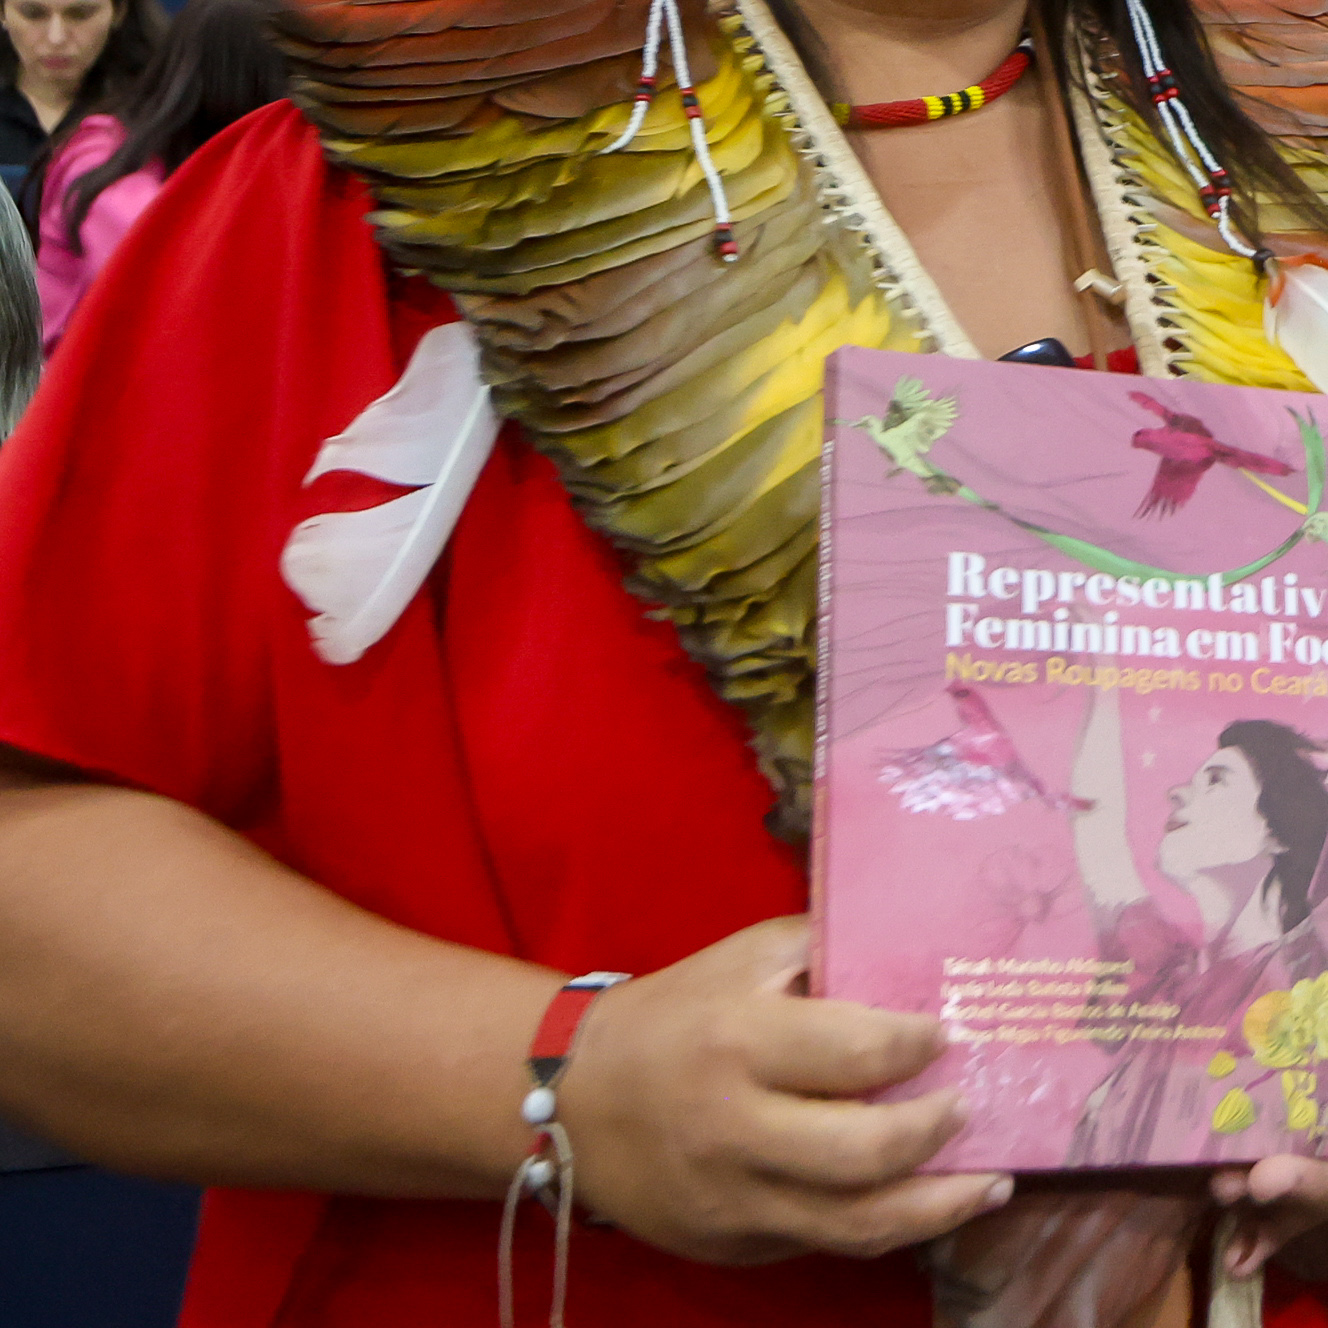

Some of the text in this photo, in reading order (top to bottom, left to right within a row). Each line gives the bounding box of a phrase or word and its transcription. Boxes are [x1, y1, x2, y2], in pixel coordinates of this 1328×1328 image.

[945, 602, 1181, 658] Feminina
[1186, 628, 1261, 663] em
[945, 651, 1038, 684] Novas
[1045, 656, 1200, 695] Roupagens
[1208, 672, 1244, 692] no
